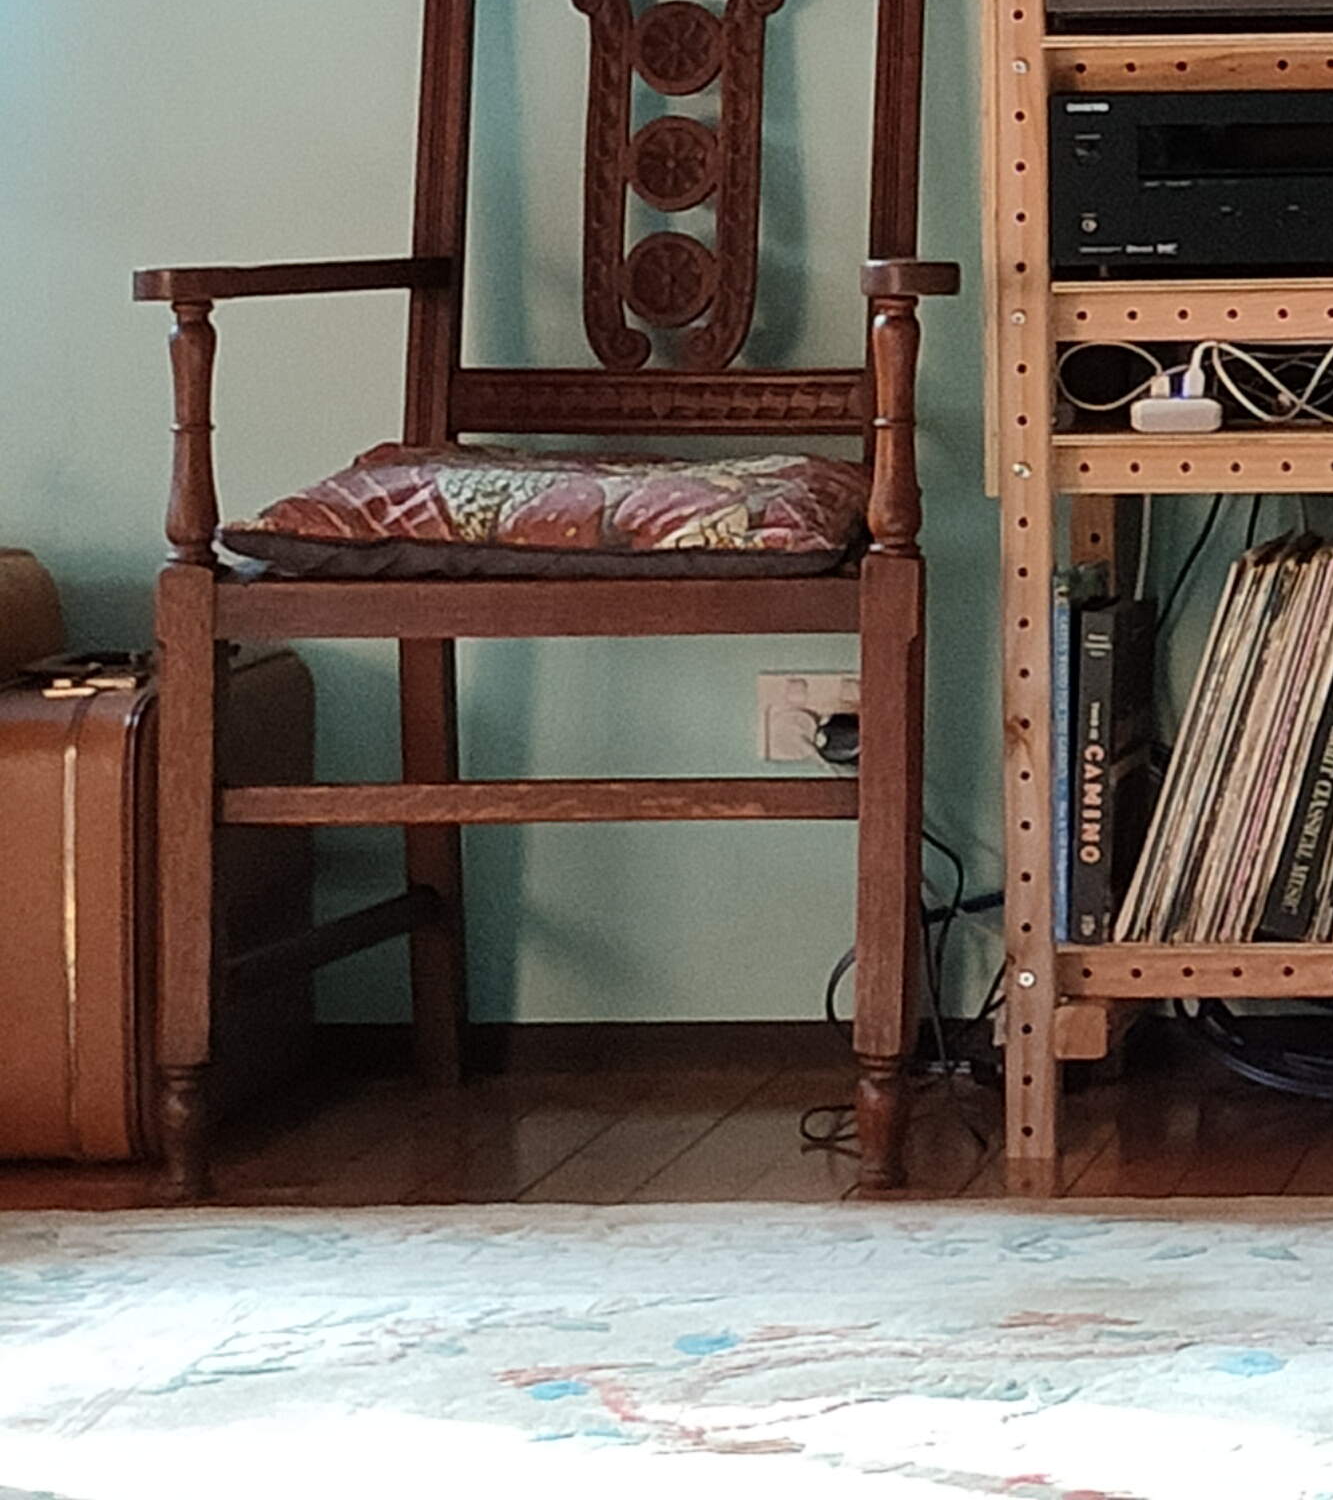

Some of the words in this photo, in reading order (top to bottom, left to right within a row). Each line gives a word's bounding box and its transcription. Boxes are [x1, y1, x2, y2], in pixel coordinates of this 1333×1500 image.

[1079, 744, 1105, 864] CAMINO
[1294, 779, 1333, 859] CLASSICAL
[1281, 861, 1307, 916] MUSIC
